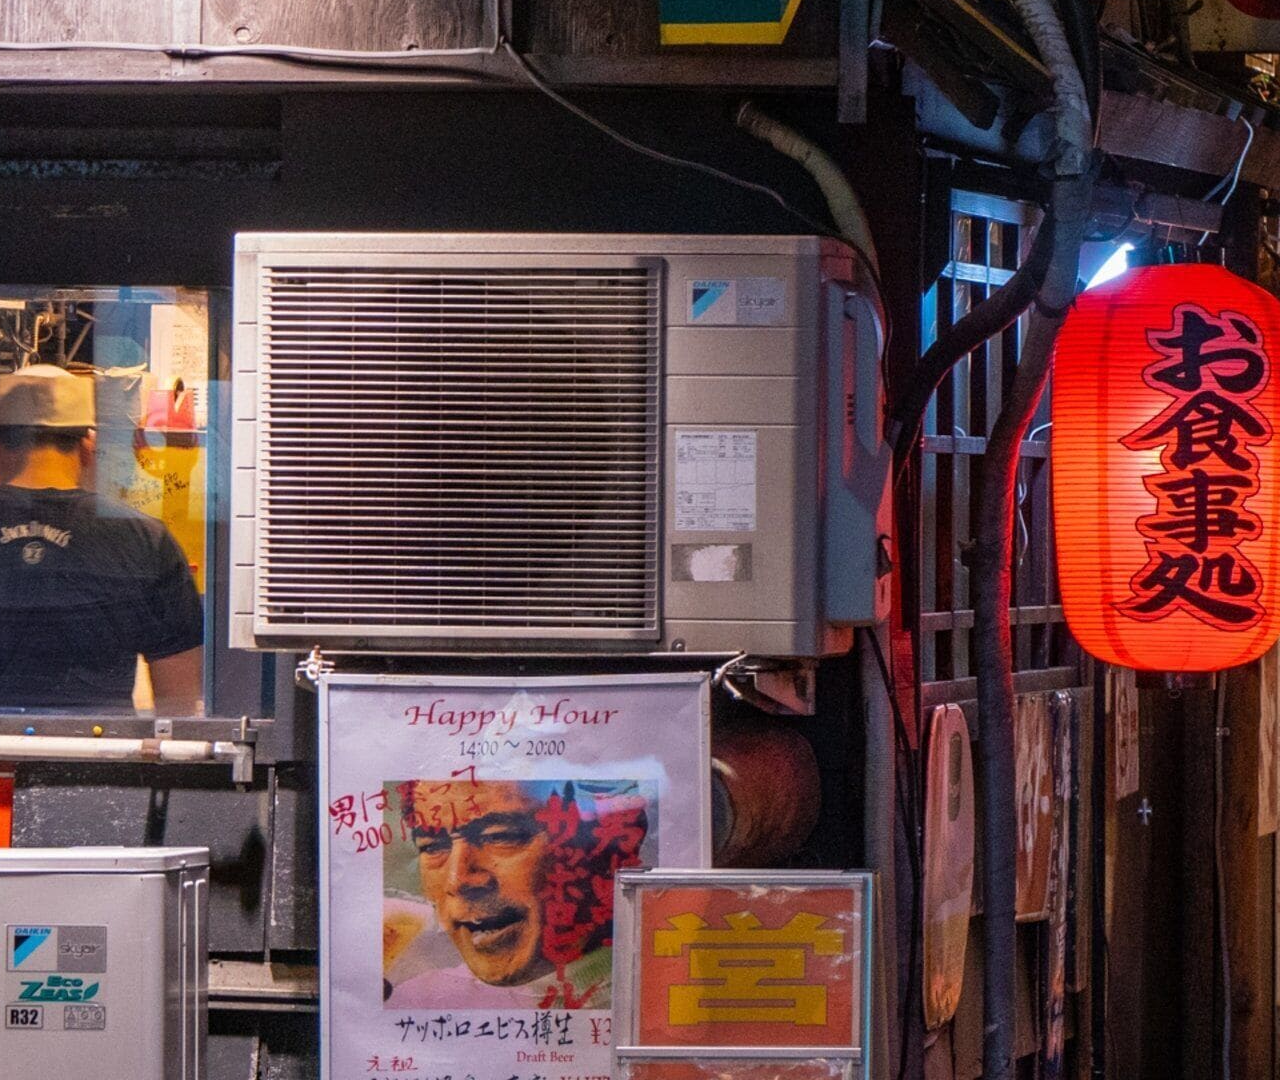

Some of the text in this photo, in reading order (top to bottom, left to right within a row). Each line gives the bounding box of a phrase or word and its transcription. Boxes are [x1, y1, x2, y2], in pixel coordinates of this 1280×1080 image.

[1124, 311, 1267, 623] お食事処
[404, 698, 619, 735] Happy Hour
[459, 740, 499, 757] 14:00
[525, 739, 566, 756] 20:00
[14, 927, 52, 936] DAIKIN
[652, 911, 847, 1026] 営
[9, 1008, 39, 1026] R32
[516, 1050, 575, 1063] Draft Beer
